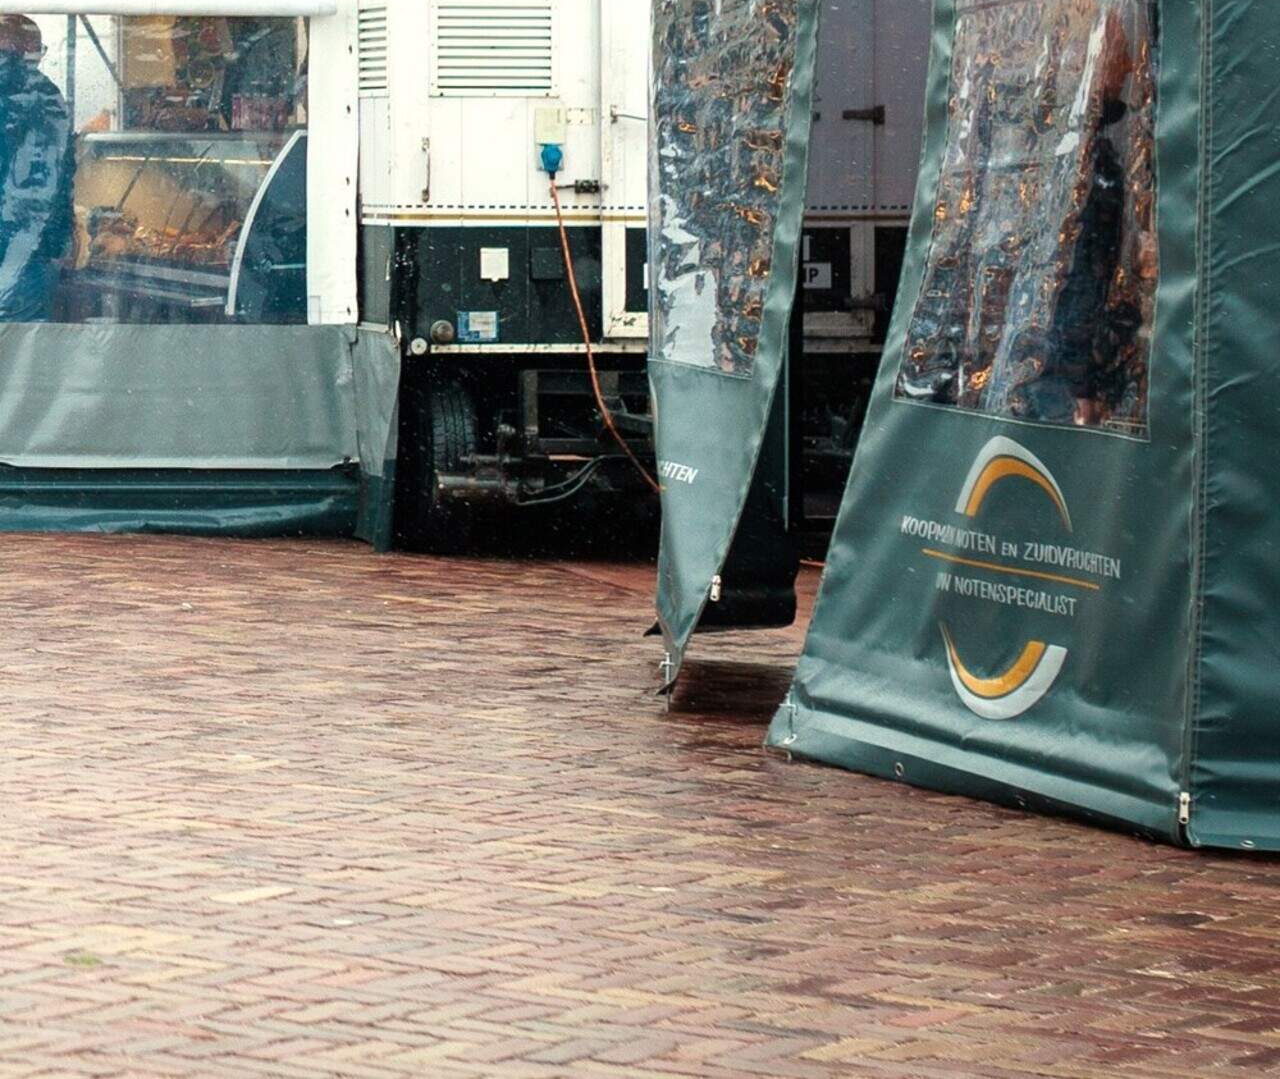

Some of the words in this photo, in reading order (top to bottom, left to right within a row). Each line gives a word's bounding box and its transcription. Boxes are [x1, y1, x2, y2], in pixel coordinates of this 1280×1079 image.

[1001, 542, 1018, 558] EN
[1024, 542, 1121, 579] ZUIDVRUCHTEN
[954, 576, 1077, 617] NOTENSPECIALIST
